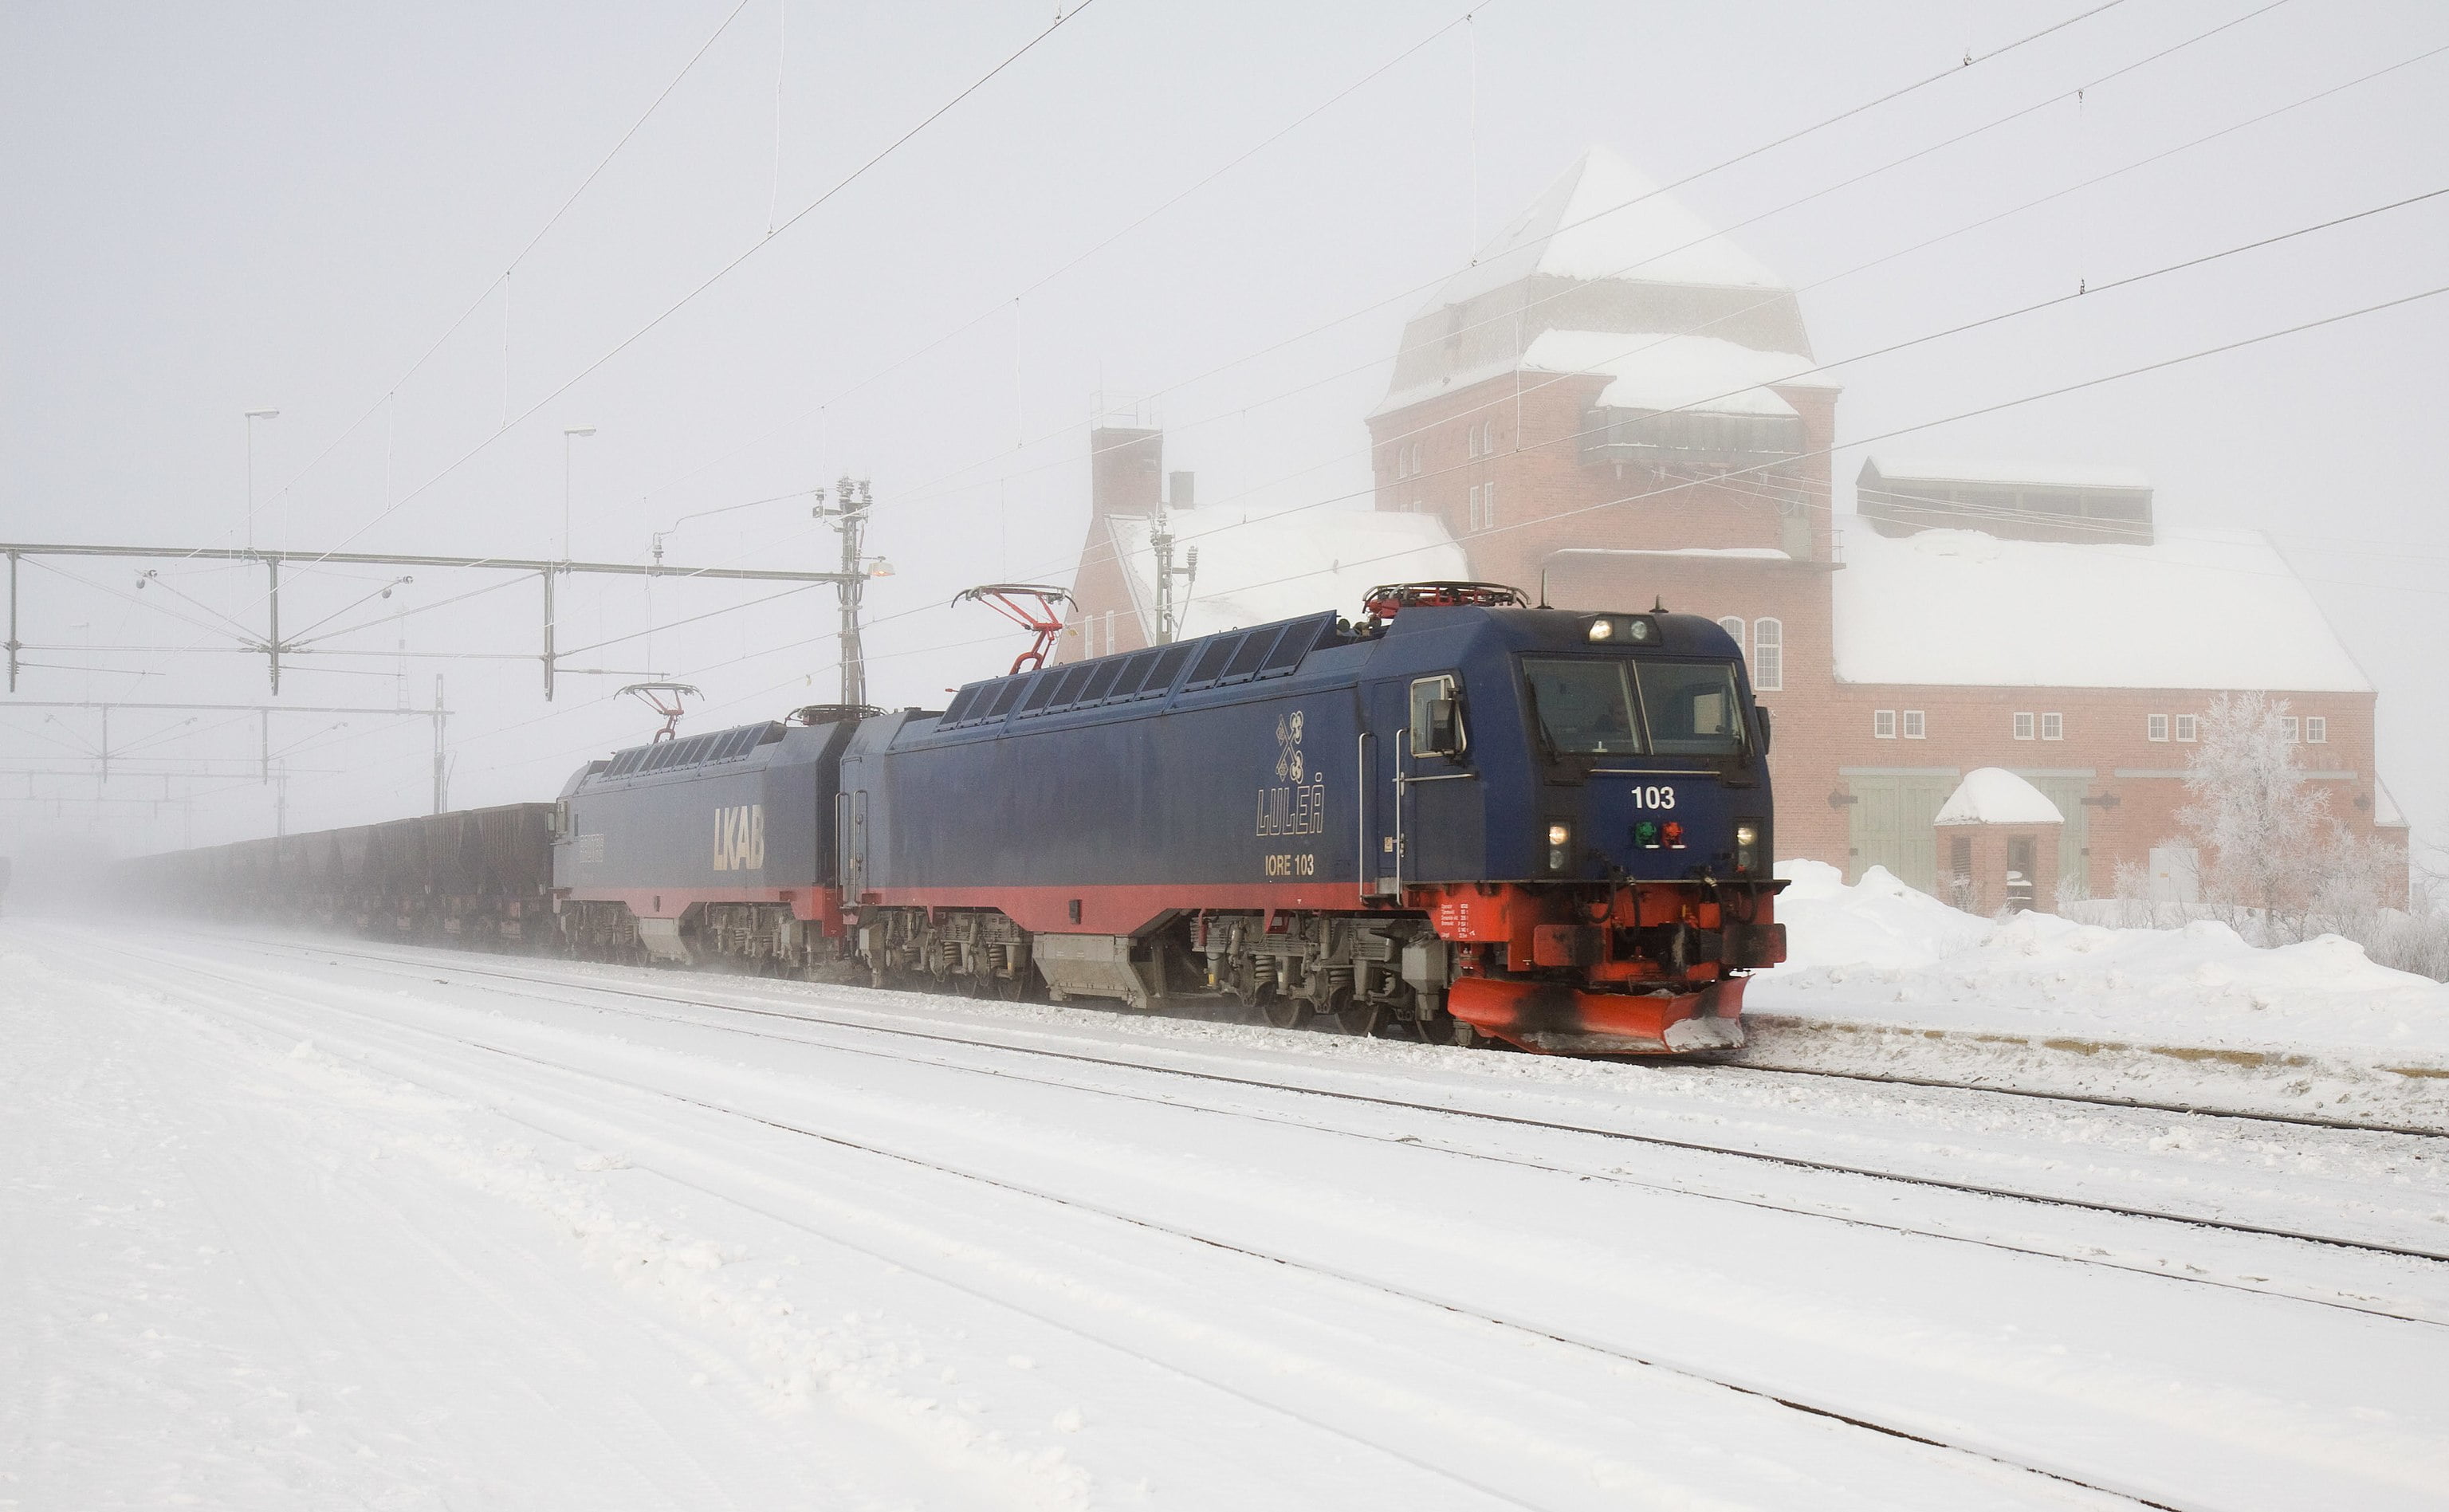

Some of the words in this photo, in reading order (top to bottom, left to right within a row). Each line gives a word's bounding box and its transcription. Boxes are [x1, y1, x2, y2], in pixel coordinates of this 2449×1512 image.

[1256, 772, 1324, 836] LULEÅ
[1631, 786, 1675, 809] 103
[713, 804, 765, 870] LKAB
[1265, 854, 1291, 876] IORE
[1295, 854, 1314, 876] 103
